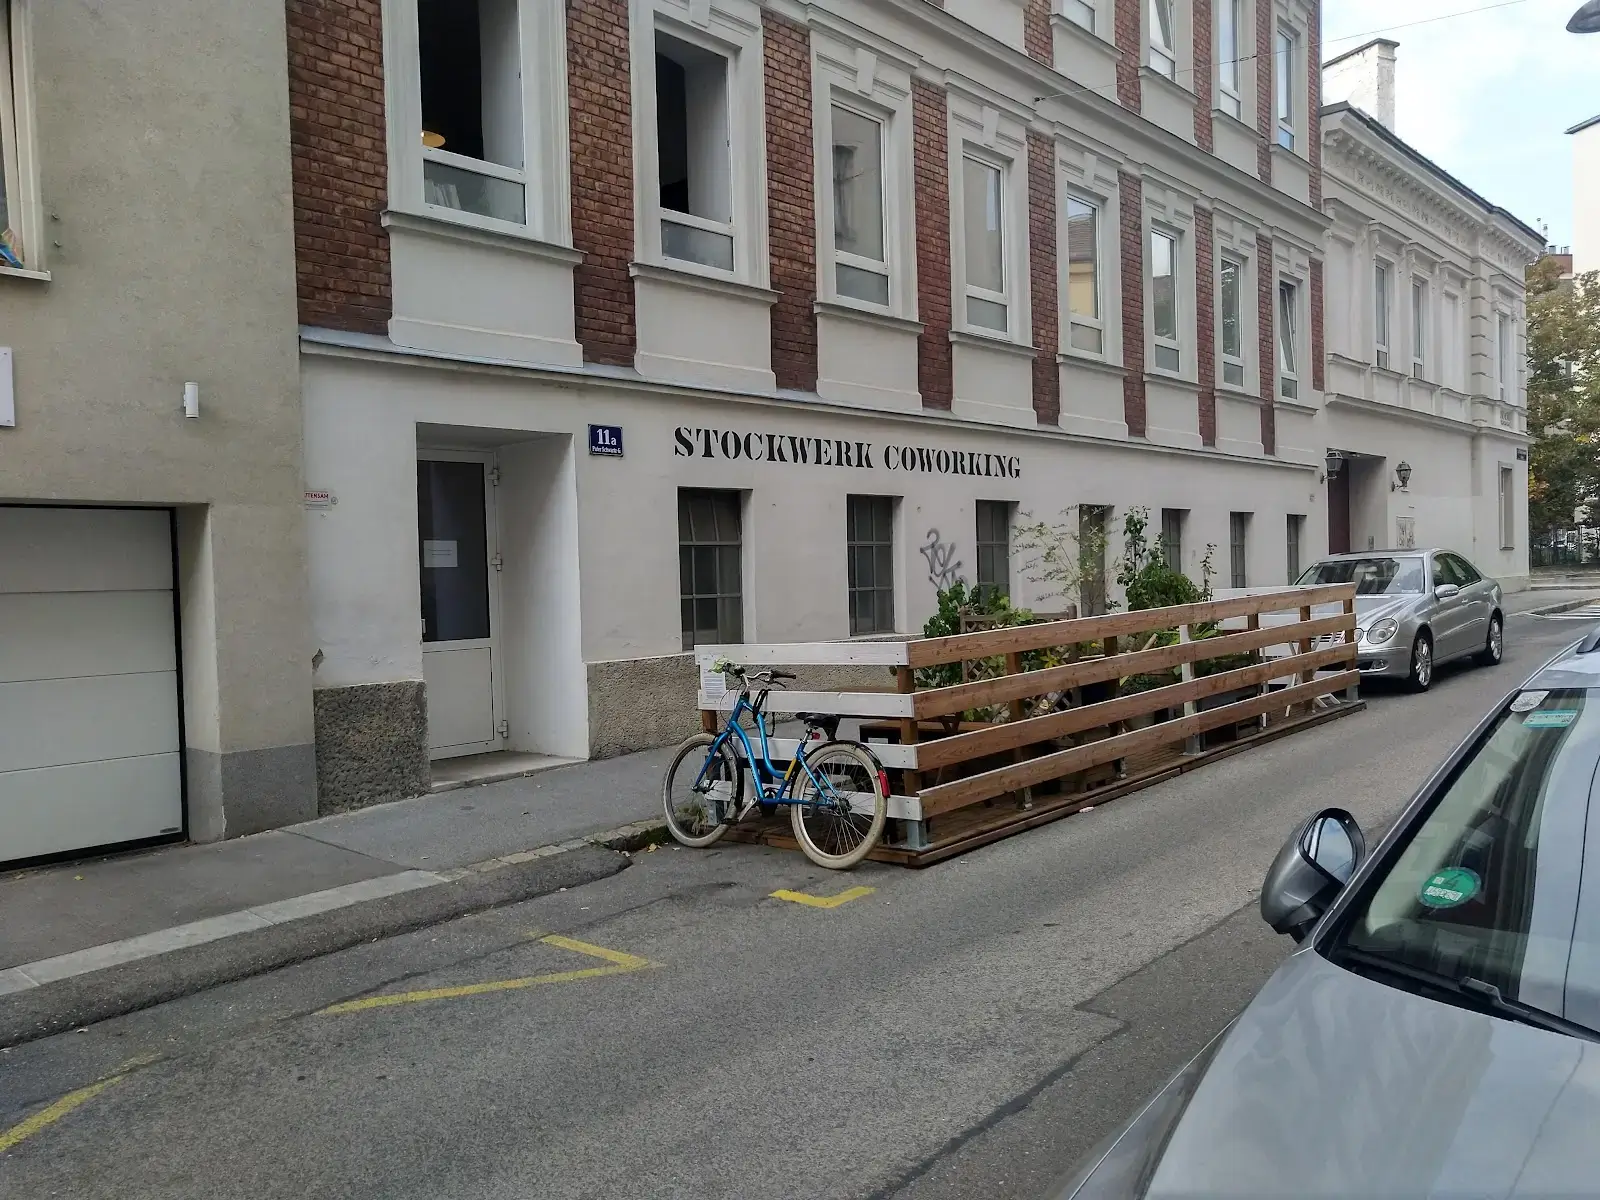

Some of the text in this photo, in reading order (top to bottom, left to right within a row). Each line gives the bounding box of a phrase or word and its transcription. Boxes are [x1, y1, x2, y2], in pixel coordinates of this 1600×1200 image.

[596, 428, 617, 446] 11a
[675, 427, 1020, 478] STOCKWERK COWORKING
